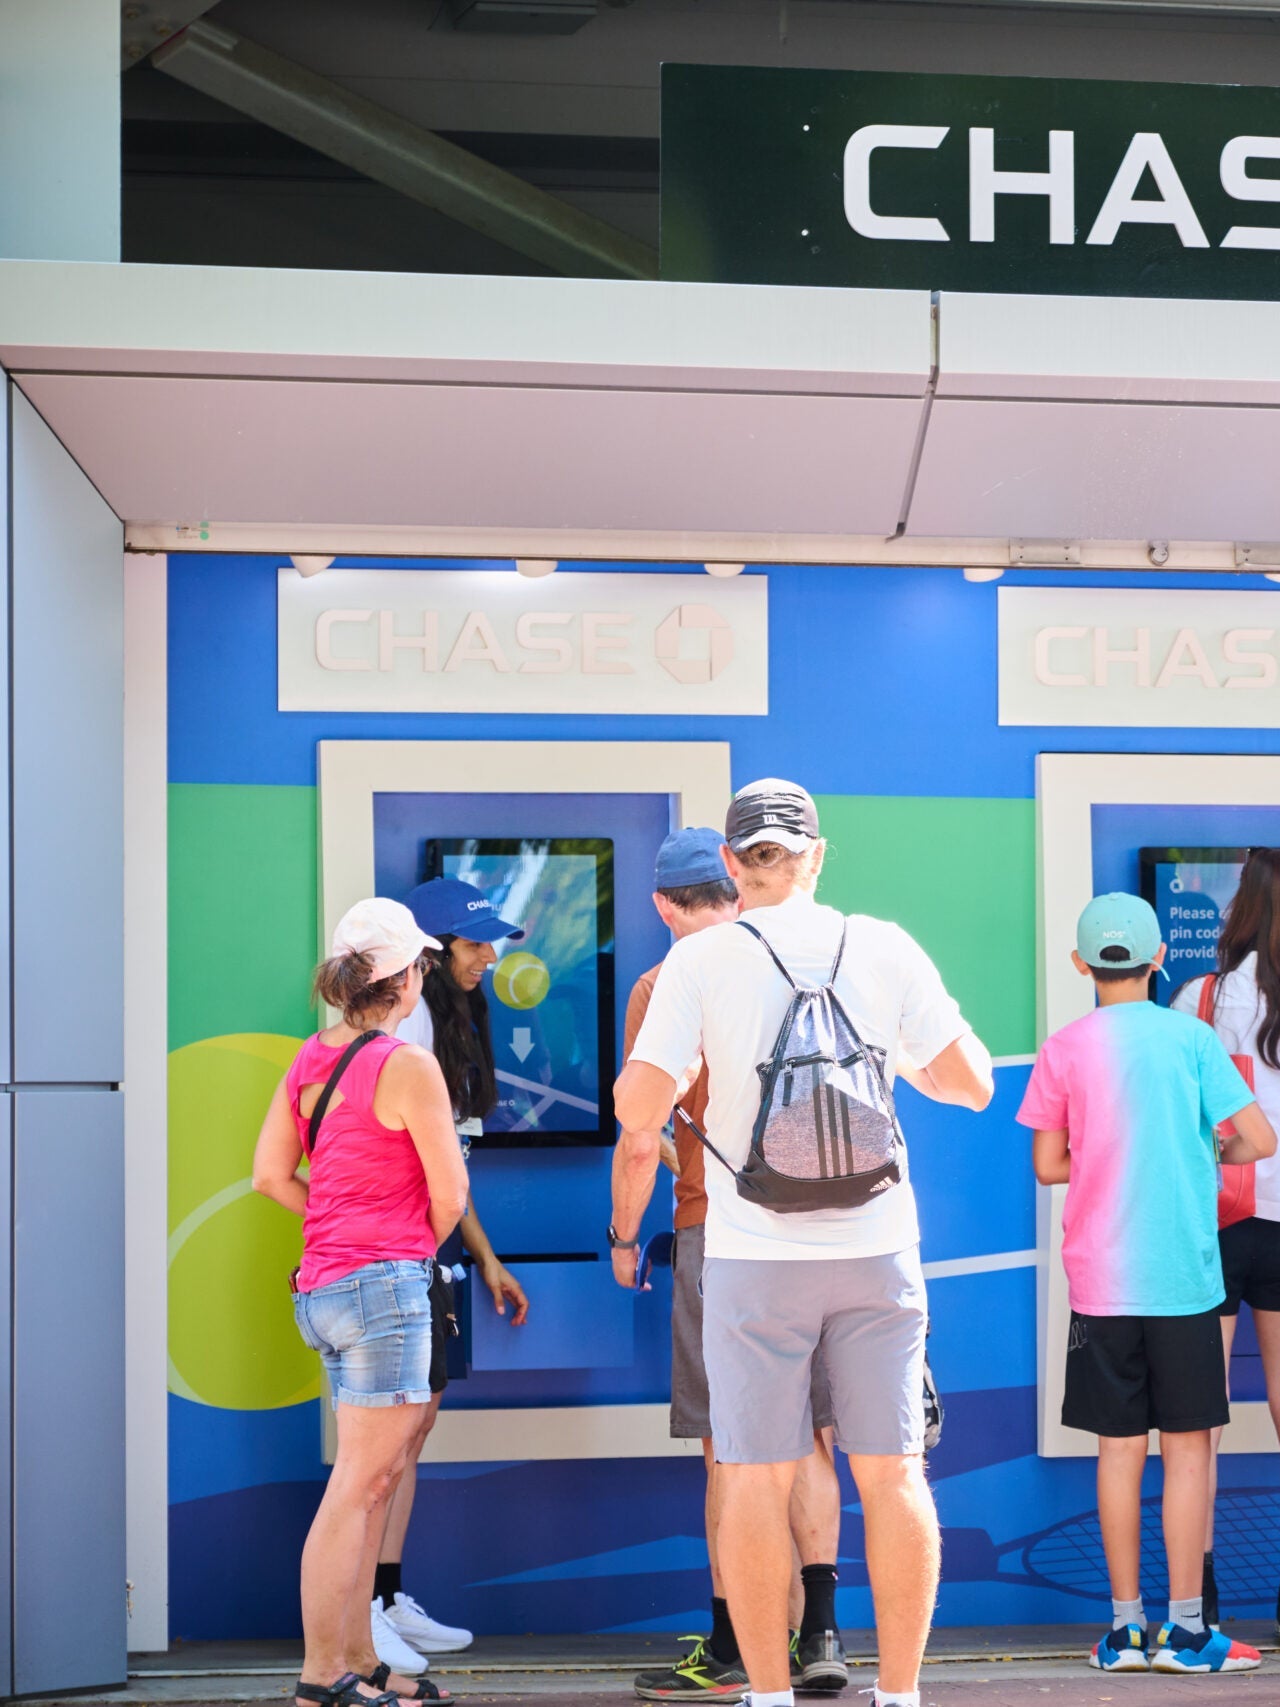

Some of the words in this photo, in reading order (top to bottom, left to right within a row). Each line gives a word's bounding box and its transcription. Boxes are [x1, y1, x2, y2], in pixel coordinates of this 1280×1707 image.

[315, 608, 636, 675] CHASE
[1170, 906, 1215, 920] Please
[1170, 926, 1192, 942] pin
[1196, 926, 1221, 939] cod
